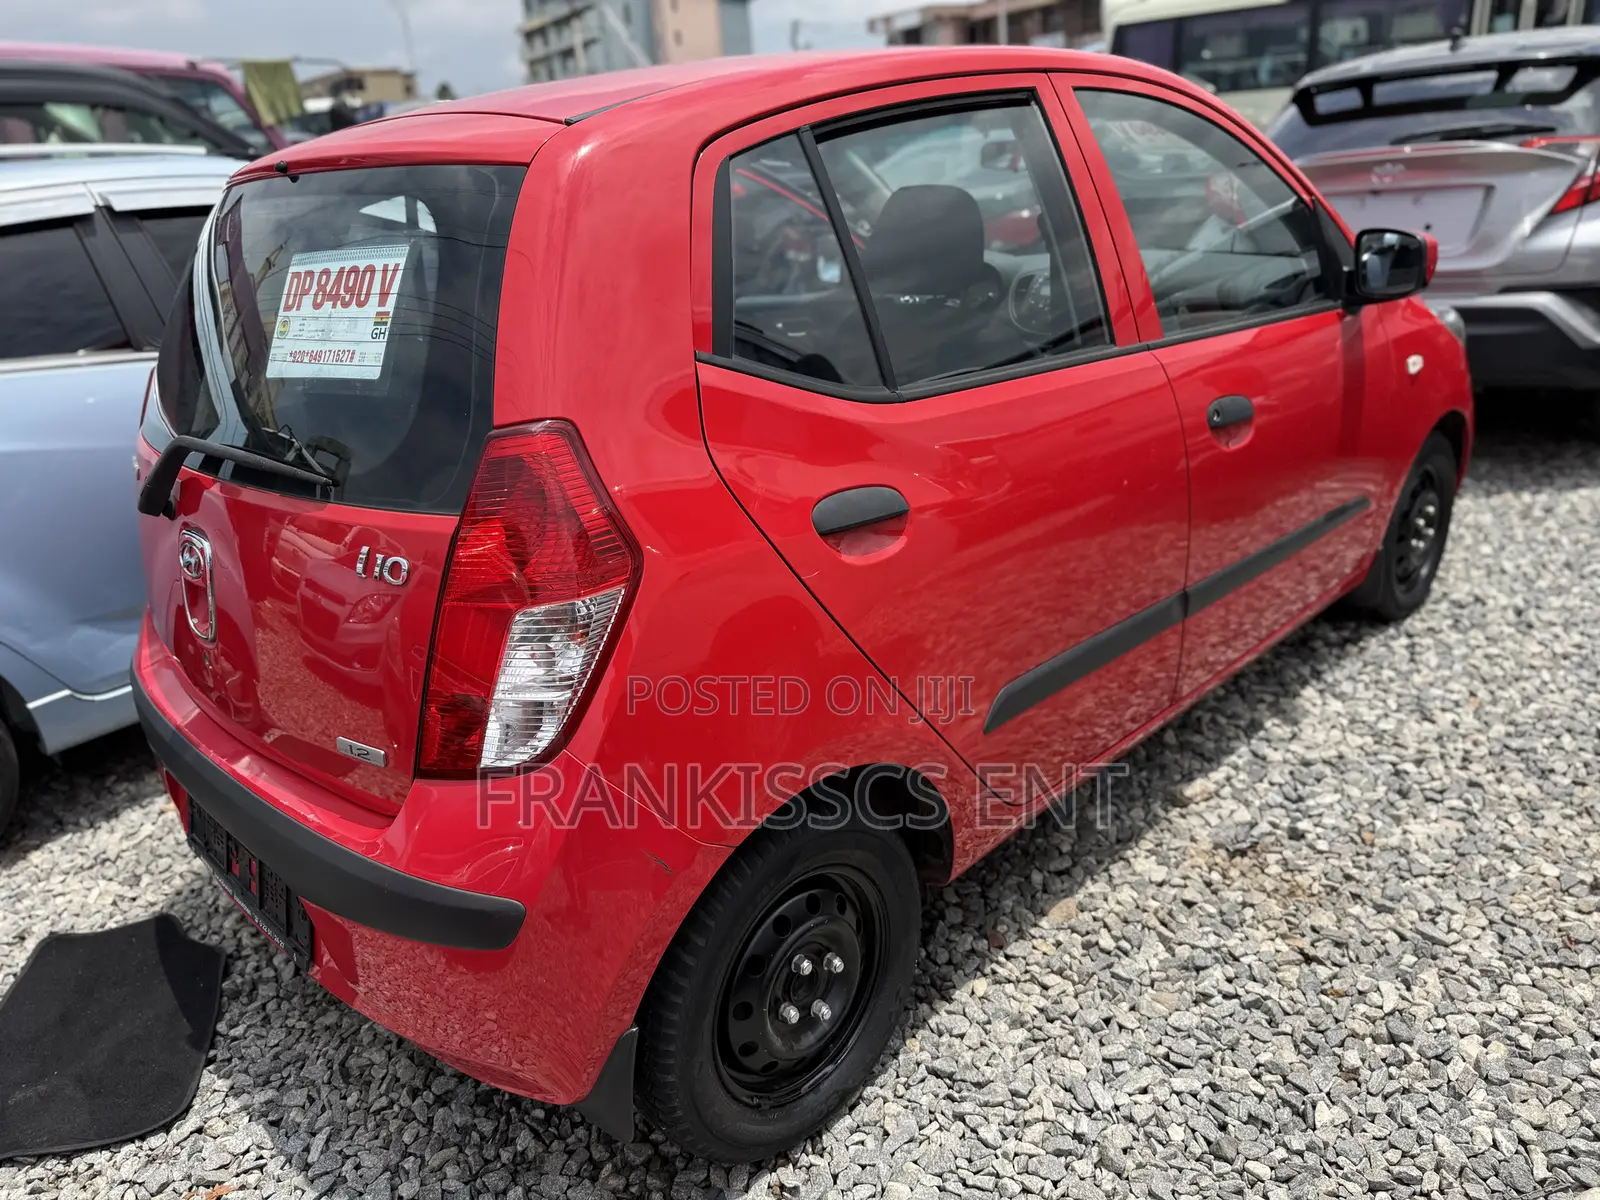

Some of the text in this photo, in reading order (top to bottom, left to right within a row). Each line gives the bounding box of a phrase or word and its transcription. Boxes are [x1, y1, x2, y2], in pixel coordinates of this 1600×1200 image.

[283, 263, 401, 313] DP 8490 V
[371, 327, 386, 340] GH
[347, 744, 372, 762] 1.2
